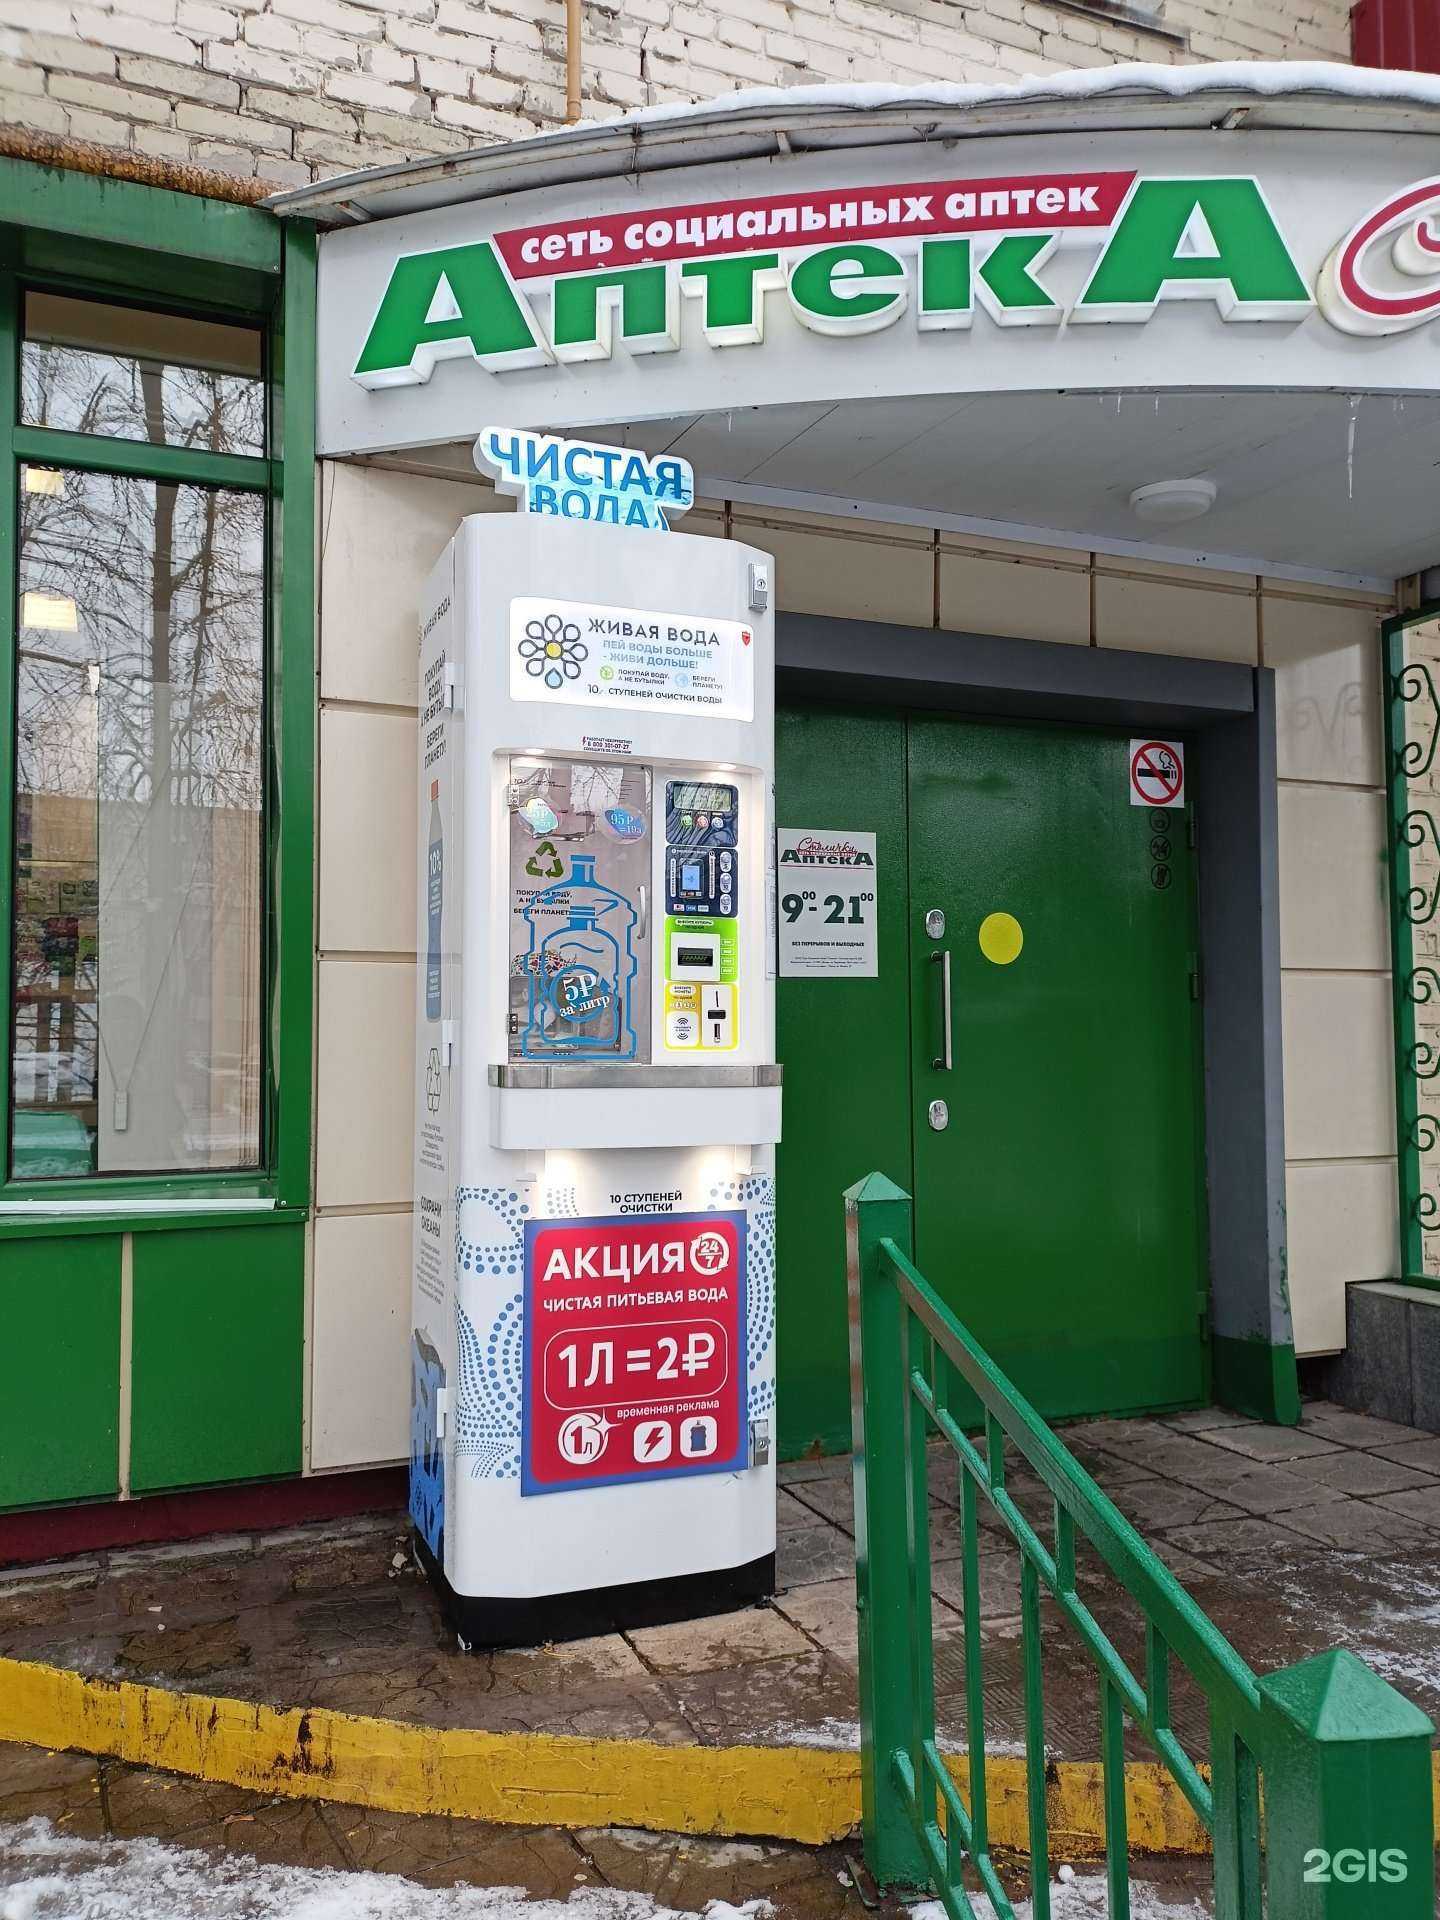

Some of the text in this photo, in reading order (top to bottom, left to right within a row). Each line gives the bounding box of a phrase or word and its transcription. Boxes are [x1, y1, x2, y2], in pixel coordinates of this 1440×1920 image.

[521, 186, 1099, 263] сеть социальных аптек
[353, 178, 1312, 375] АптекА
[490, 434, 682, 499] ЧИСТАЯ
[535, 484, 650, 529] ВОДА
[588, 618, 720, 646] ЖИВАЯ ВОДА
[603, 640, 712, 659] ПЕЙ ВОДЫ БОЛЬШЕ
[610, 653, 643, 664] ЖИВИ
[647, 656, 698, 669] ДОЛЬШЕ!
[618, 669, 649, 677] ПОКУПАЙ
[588, 684, 722, 704] 10 СТУПЕНЕЙ ОЧИСТКИ ВОДЫ
[780, 849, 874, 866] АптекА
[560, 995, 610, 1017] за литр
[610, 1190, 682, 1204] 10 СТУПЕНЕЙ
[620, 1202, 673, 1214] ОЧИСТКИ
[543, 1241, 685, 1284] АКЦИЯ
[543, 1287, 729, 1313] ЧИСТАЯ ПИТЬЕВАЯ ВОДА
[617, 1399, 720, 1419] временная реклама
